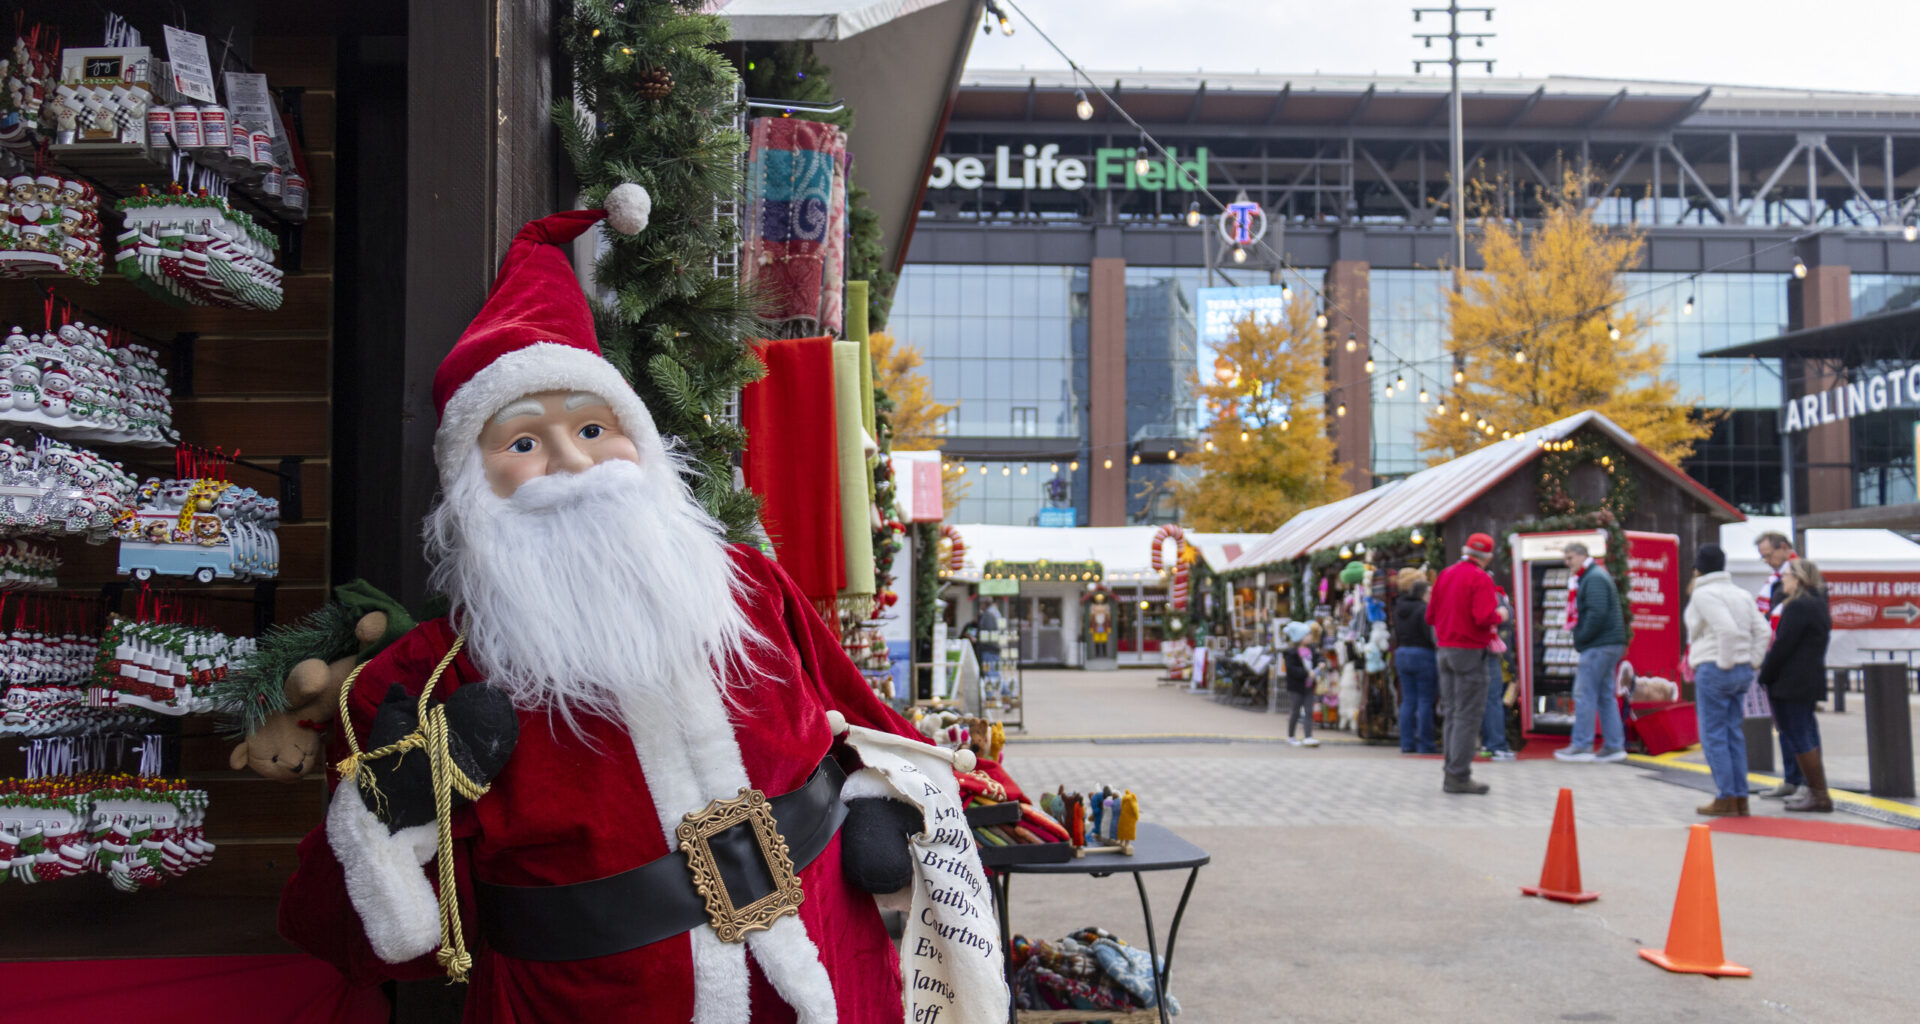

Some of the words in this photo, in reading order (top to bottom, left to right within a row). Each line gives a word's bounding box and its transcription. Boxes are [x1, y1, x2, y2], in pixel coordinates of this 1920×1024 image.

[995, 144, 1087, 190] Life
[1096, 147, 1208, 191] Field
[1227, 202, 1259, 244] T
[1878, 582, 1890, 596] IS
[930, 827, 971, 854] Billy
[921, 850, 982, 897] Brittney
[921, 907, 993, 957] Courtney
[914, 937, 943, 964] Eve
[912, 969, 955, 1004] Jamie
[912, 1002, 943, 1024] Jeff
